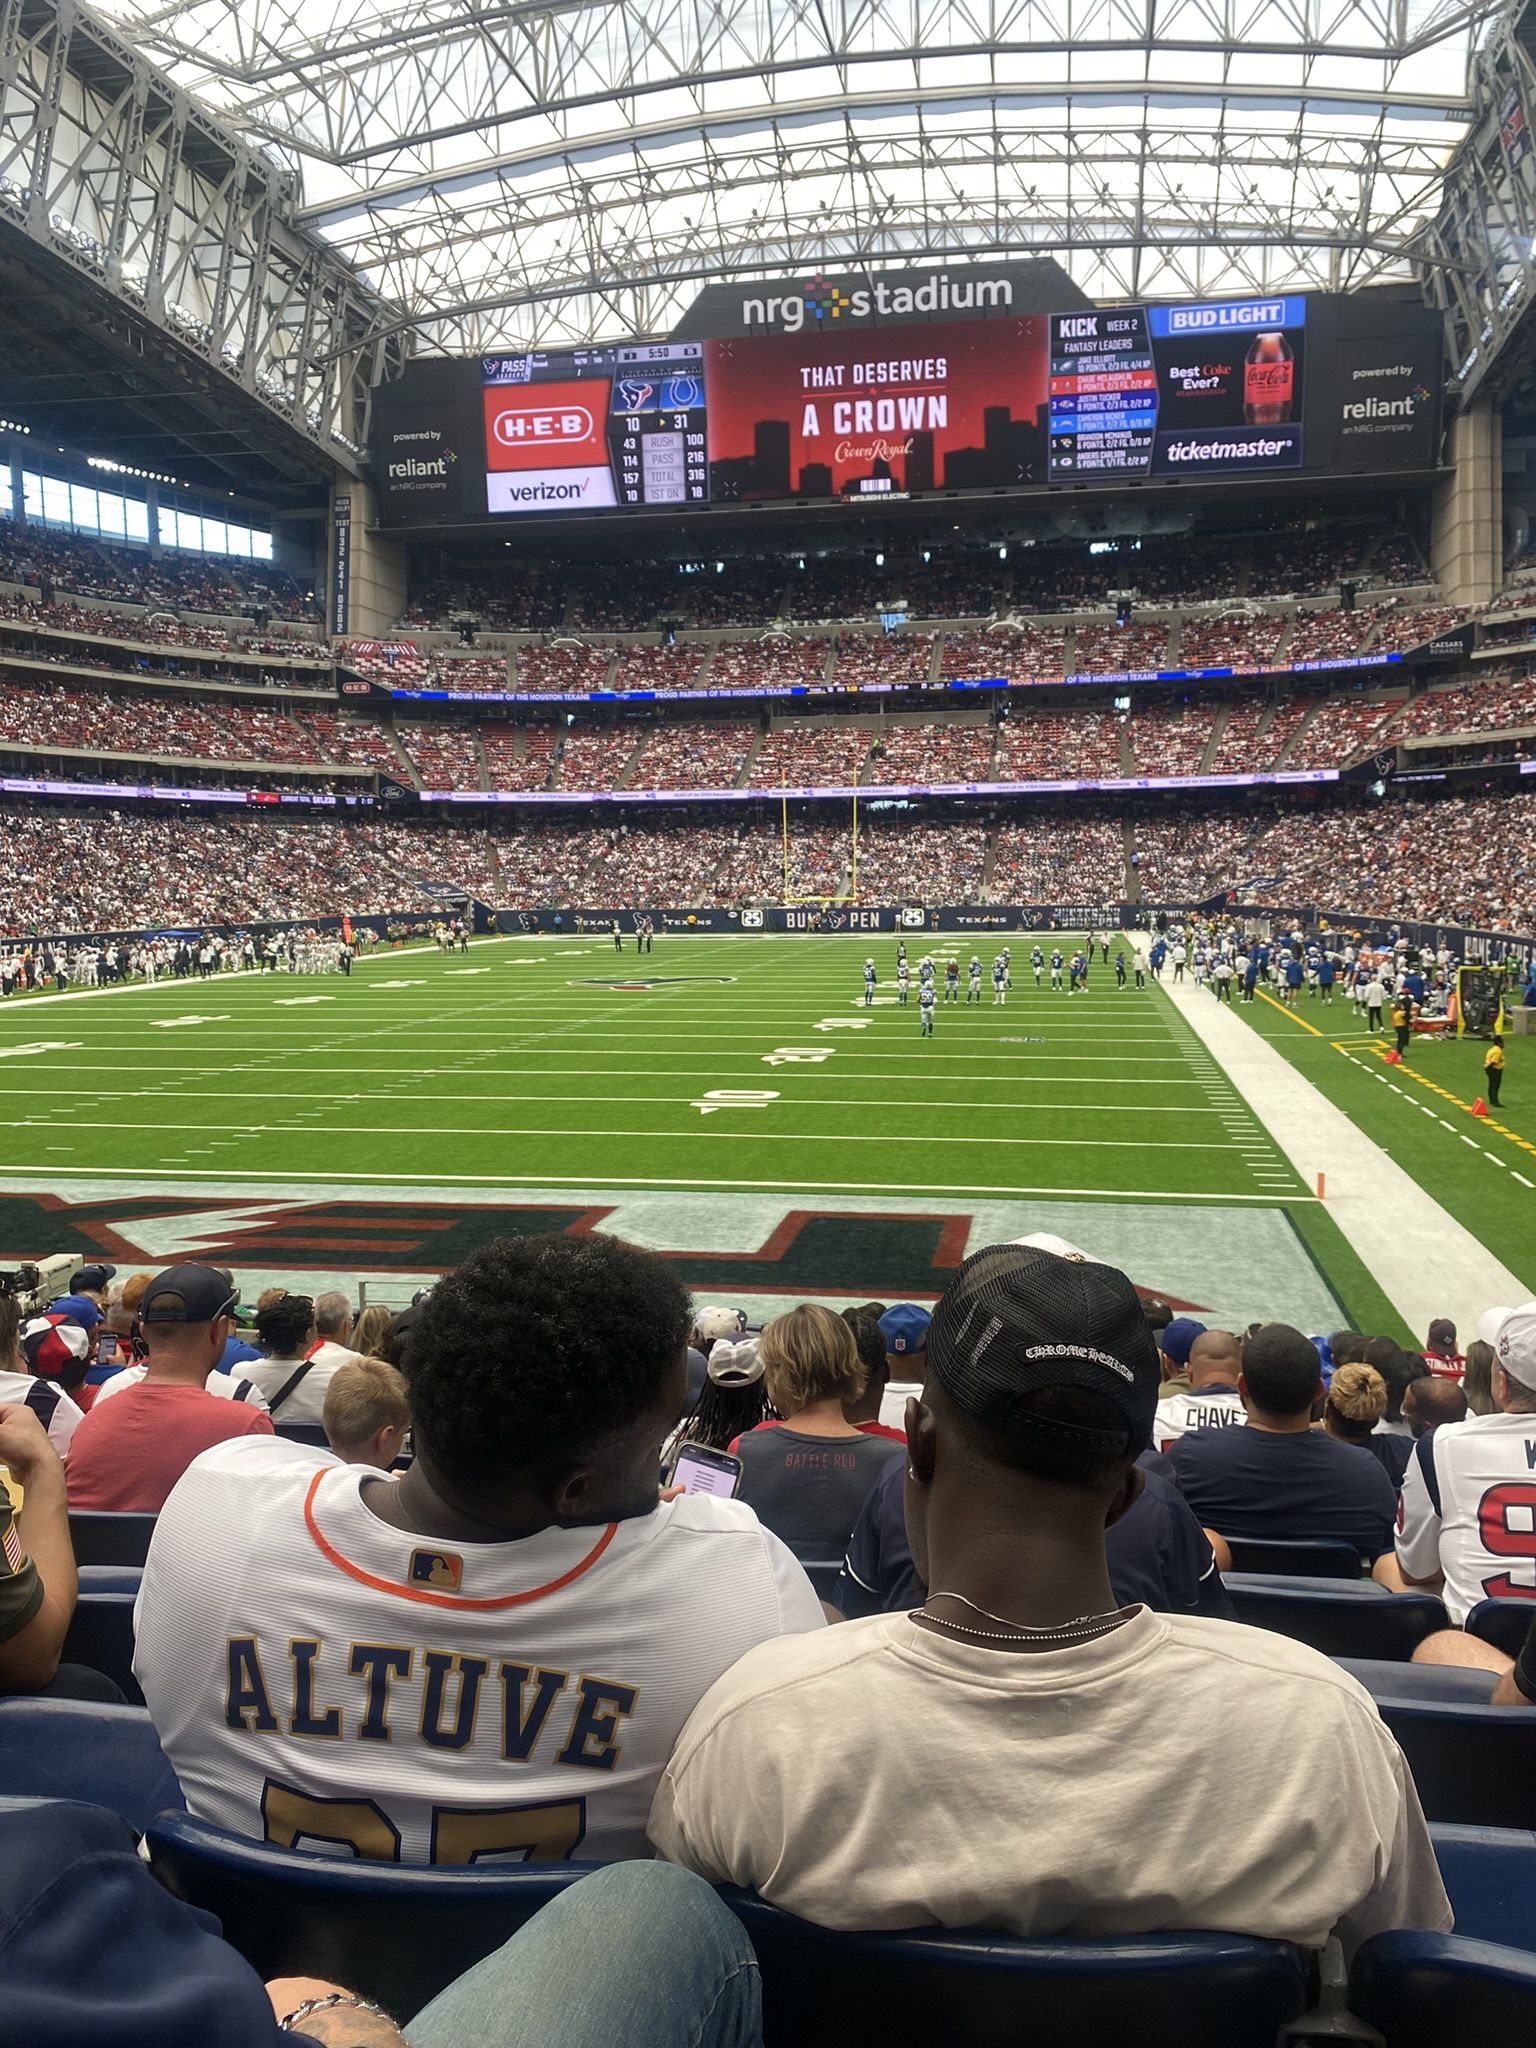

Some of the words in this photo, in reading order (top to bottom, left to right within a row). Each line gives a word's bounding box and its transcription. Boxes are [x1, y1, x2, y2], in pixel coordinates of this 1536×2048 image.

[743, 296, 804, 332] nrg
[851, 275, 1012, 317] stadium
[1173, 310, 1217, 329] BUD
[1219, 305, 1280, 324] LIGHT
[1060, 317, 1098, 338] KICK
[1106, 320, 1130, 332] WEEK
[1131, 319, 1138, 330] 2
[649, 347, 669, 358] 5:50
[1064, 341, 1098, 353] FANTASY
[1099, 339, 1133, 351] LEADERS
[501, 359, 526, 373] PASS
[800, 365, 845, 388] THAT
[853, 358, 947, 384] DESERVES
[1170, 366, 1200, 379] Best
[1353, 365, 1399, 380] powered
[1400, 365, 1413, 376] by
[1183, 377, 1219, 390] Ever?
[802, 404, 820, 437] A
[833, 395, 947, 435] CROWN
[1343, 396, 1415, 419] reliant
[626, 417, 640, 432] 10
[674, 414, 688, 429] 31
[1354, 424, 1373, 433] NRG
[1375, 424, 1414, 432] company
[393, 431, 429, 443] powered
[430, 431, 441, 440] by
[623, 438, 636, 449] 43
[651, 436, 674, 448] RUSH
[686, 434, 704, 446] 100
[835, 441, 873, 463] Crown
[866, 437, 914, 462] Royal
[1167, 439, 1286, 462] ticketmaster
[389, 458, 447, 477] reliant
[623, 455, 638, 467] 114
[652, 453, 674, 464] PASS
[687, 451, 704, 463] 216
[623, 472, 639, 484] 157
[651, 471, 675, 482] TOTAL
[688, 469, 705, 481] 316
[509, 482, 581, 501] verizon
[626, 490, 638, 501] 10
[691, 486, 703, 498] 18
[1430, 640, 1463, 648] CAESARS
[851, 911, 879, 928] PEN
[689, 1090, 781, 1115] 10
[1186, 1407, 1249, 1429] CHAVE
[785, 1453, 829, 1469] BATTLE
[834, 1453, 856, 1468] RED
[225, 1634, 640, 1771] ALTUVE
